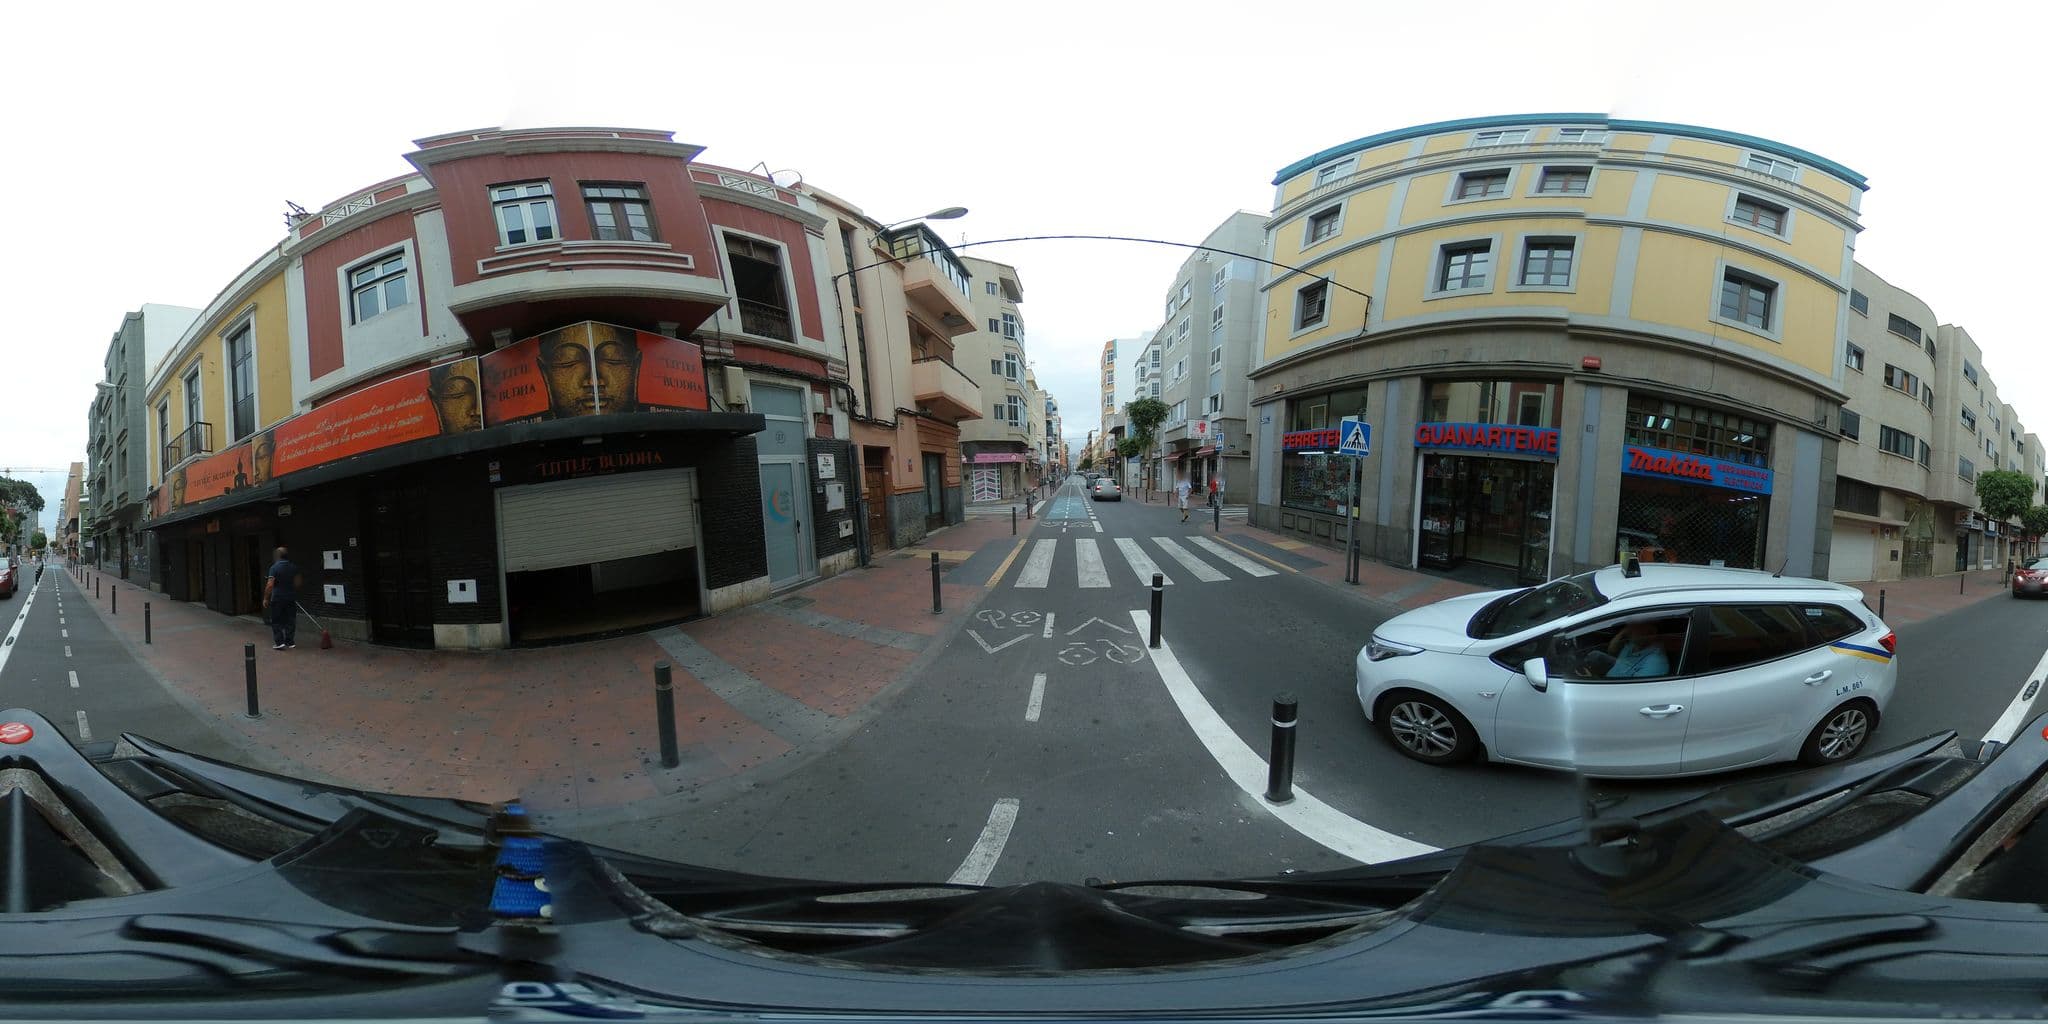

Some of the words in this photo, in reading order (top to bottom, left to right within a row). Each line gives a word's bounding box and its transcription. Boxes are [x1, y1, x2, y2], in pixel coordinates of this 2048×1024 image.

[1282, 430, 1341, 447] FERRETER
[1416, 424, 1560, 453] GUANARTEME
[536, 455, 592, 476] LITTLE
[600, 450, 664, 472] BUDDHA
